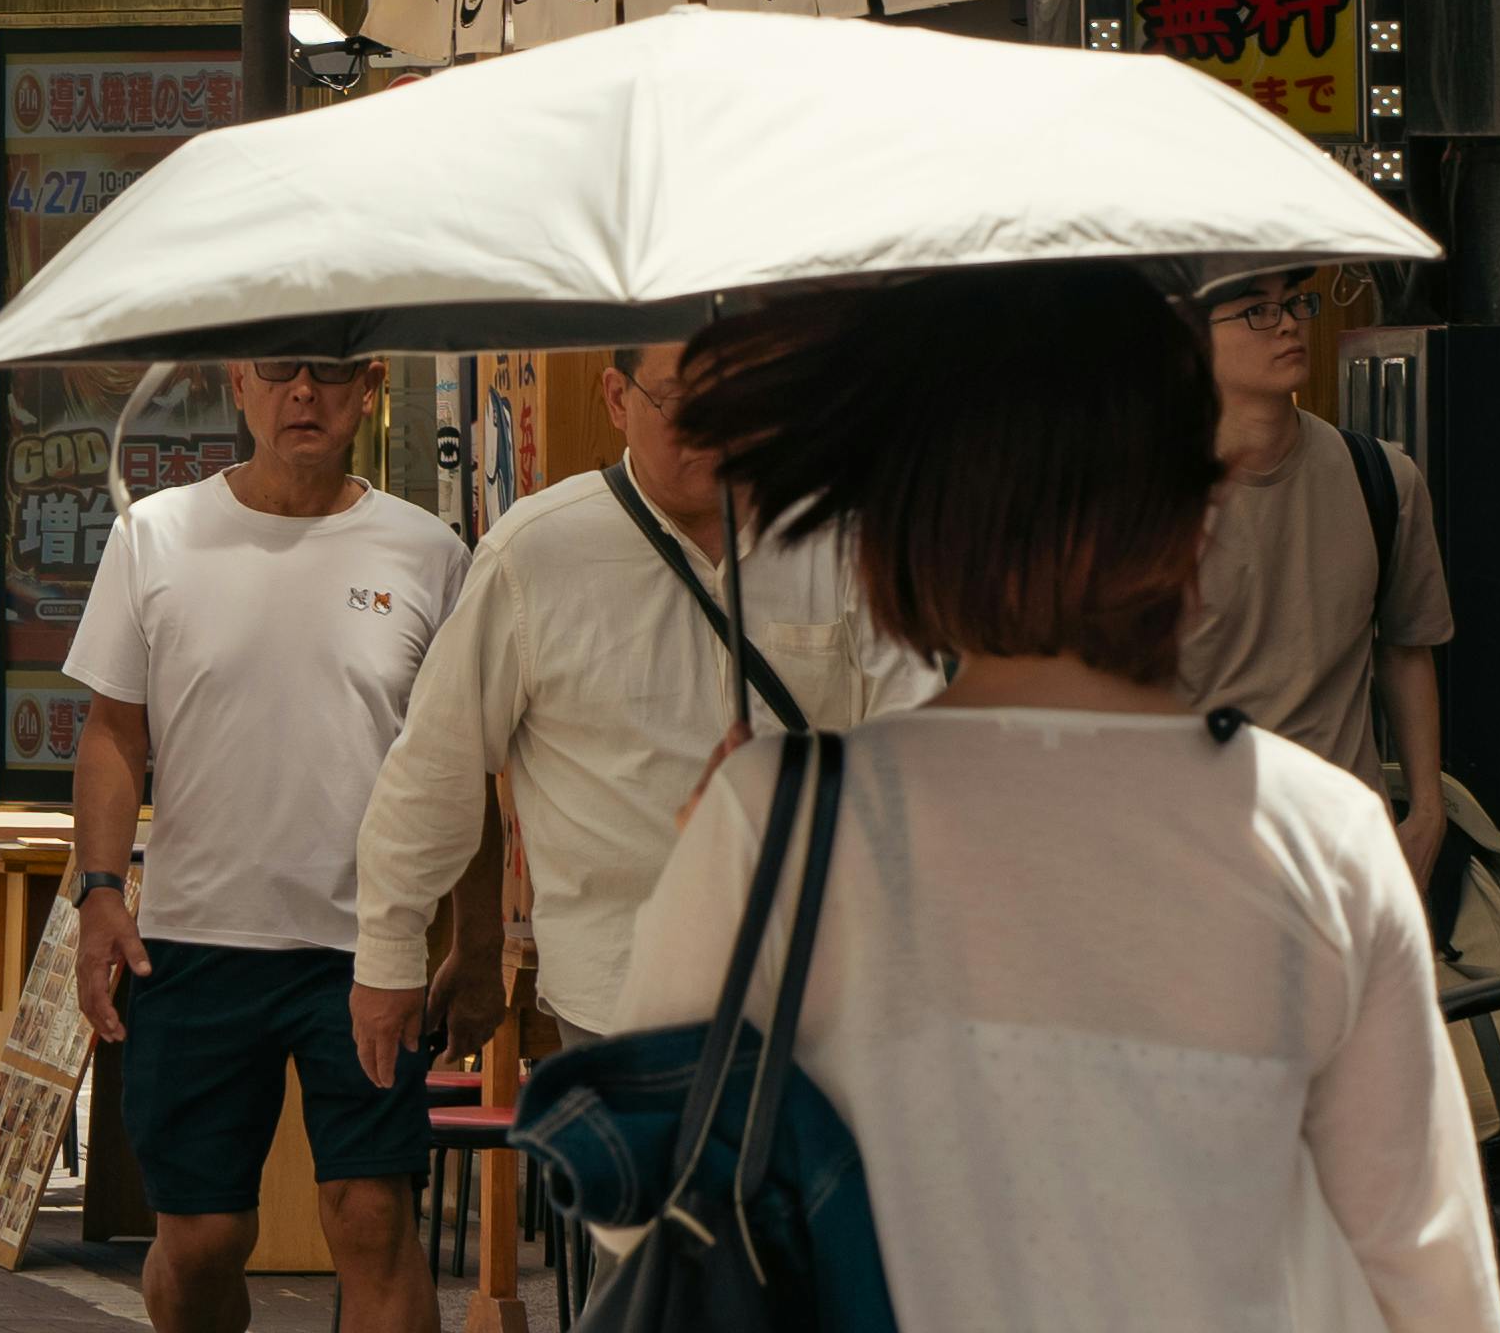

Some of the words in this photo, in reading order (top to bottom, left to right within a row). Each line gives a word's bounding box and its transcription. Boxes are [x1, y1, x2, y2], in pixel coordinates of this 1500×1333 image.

[18, 88, 39, 110] PIA
[49, 71, 244, 131] 導入機種のご案
[1222, 75, 1337, 115] まで
[9, 170, 88, 214] 4/27
[12, 431, 109, 483] GOD
[17, 712, 39, 735] PIA
